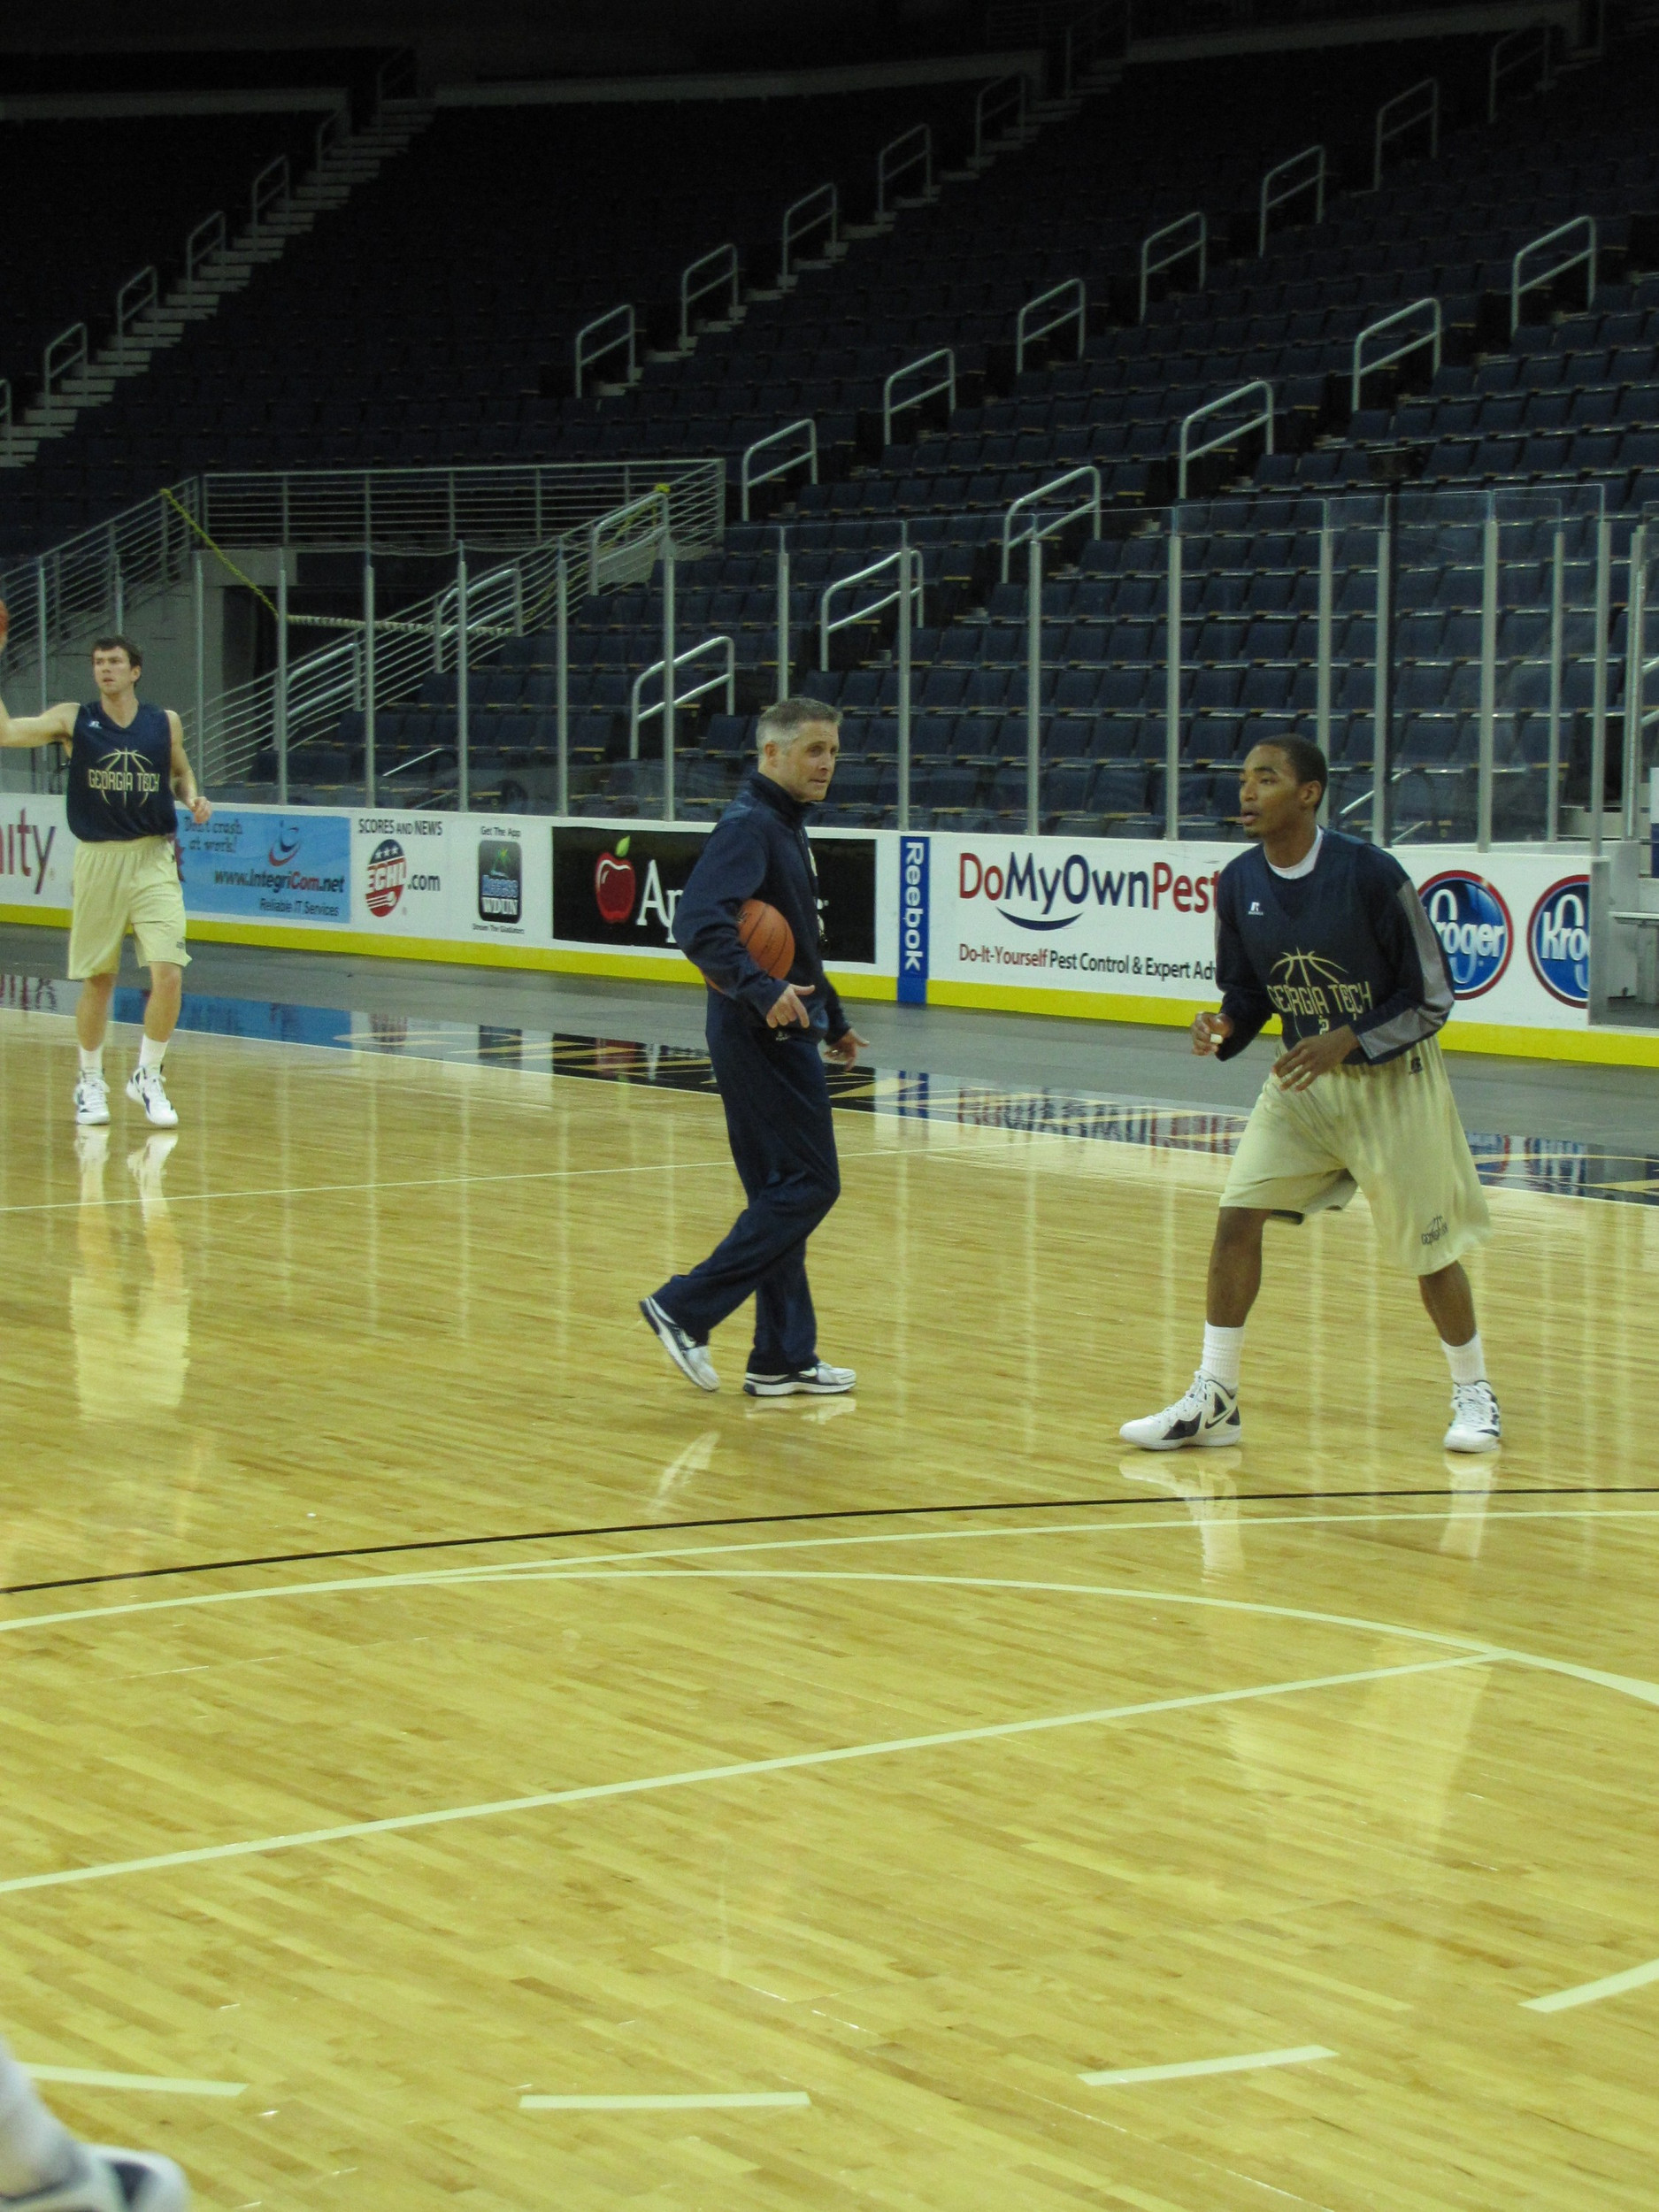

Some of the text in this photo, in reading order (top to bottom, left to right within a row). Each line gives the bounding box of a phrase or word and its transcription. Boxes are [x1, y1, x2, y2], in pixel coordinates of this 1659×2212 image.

[88, 768, 160, 792] GEORGIA TECH
[358, 818, 442, 835] SCORES AND NEWS
[367, 859, 407, 893] ECHL
[407, 873, 442, 892] .com
[259, 897, 291, 912] Reliable
[304, 901, 341, 917] Services
[903, 841, 925, 972] Reebok
[1541, 895, 1589, 992] Kro
[959, 943, 1048, 968] Do-It-Yourself
[1050, 949, 1077, 971] Pest
[1079, 952, 1129, 974] Control
[1132, 956, 1143, 973] &
[1145, 956, 1191, 981] Expert
[1266, 980, 1373, 1017] GEORGIA TECH
